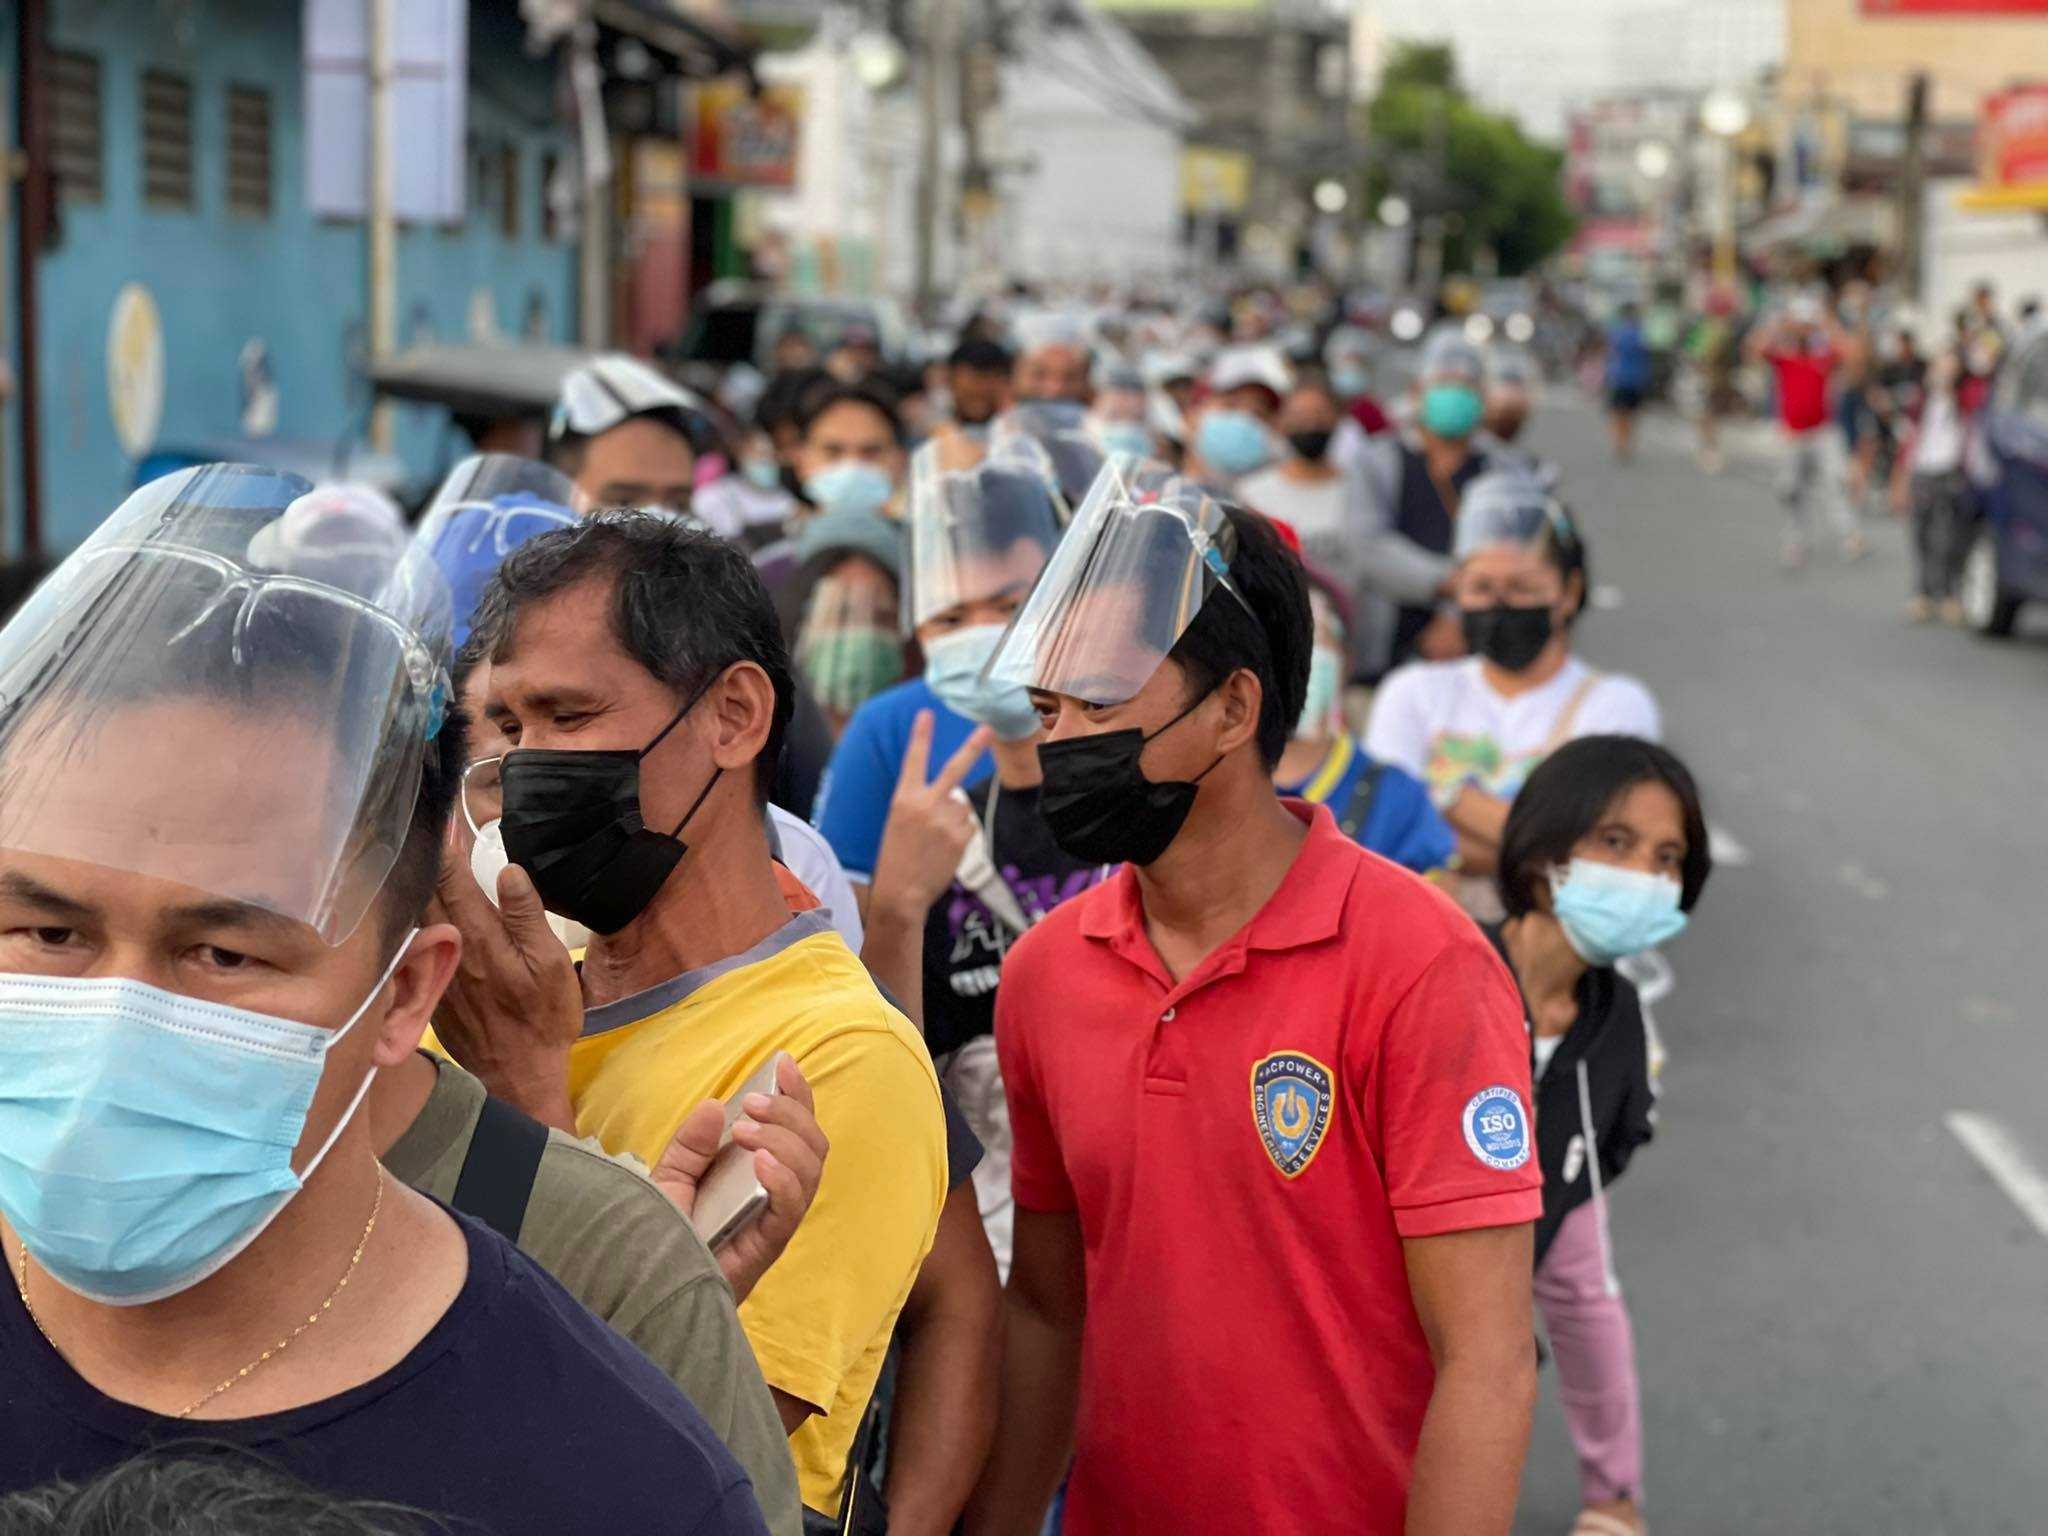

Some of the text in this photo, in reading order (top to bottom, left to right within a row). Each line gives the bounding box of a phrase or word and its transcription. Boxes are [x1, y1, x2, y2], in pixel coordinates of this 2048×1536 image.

[1265, 1060, 1321, 1083] ACPOWER
[1472, 1088, 1518, 1107] CERTIFIED
[1255, 1085, 1287, 1168] ENGINEERING
[1293, 1093, 1331, 1169] SERVICES
[1479, 1113, 1516, 1134] ISO
